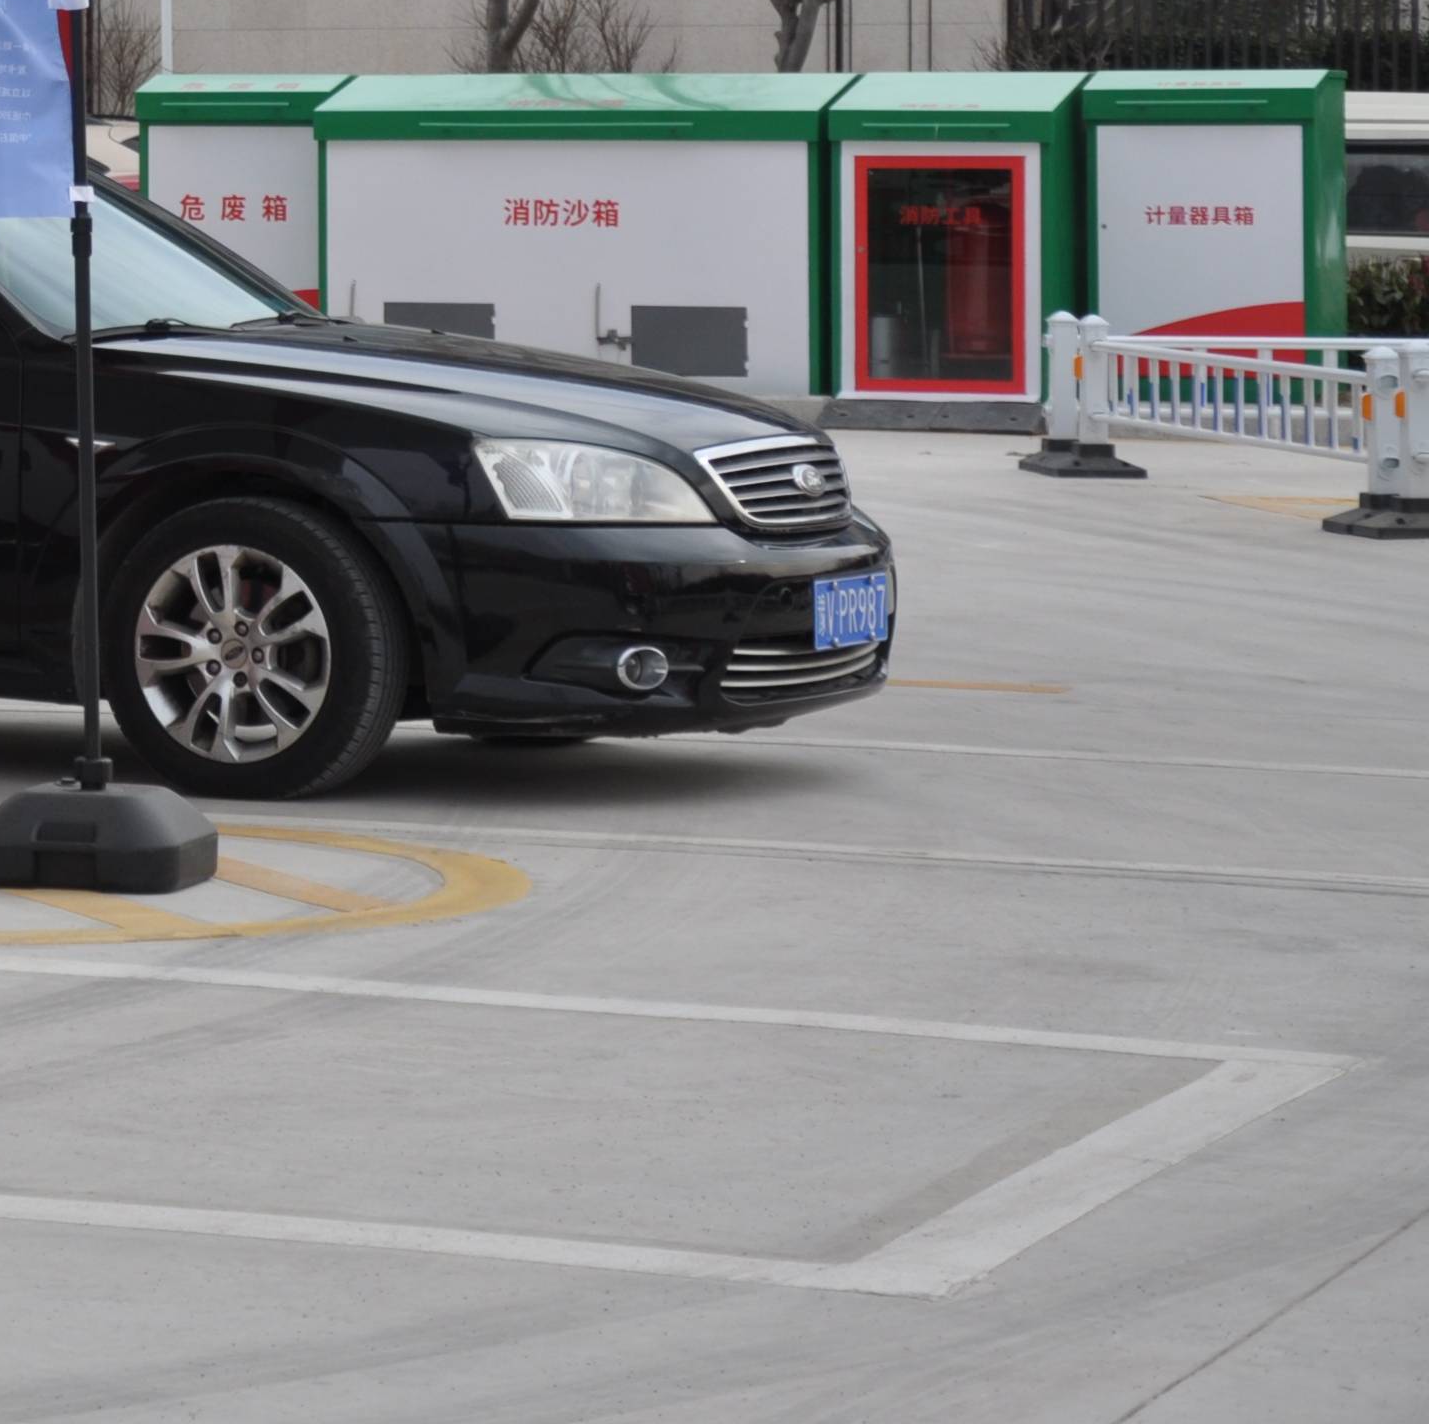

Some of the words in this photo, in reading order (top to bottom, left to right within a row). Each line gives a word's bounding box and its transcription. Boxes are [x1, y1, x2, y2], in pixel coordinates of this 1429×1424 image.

[180, 195, 288, 222] 危废箱
[504, 199, 620, 228] 消防沙箱
[901, 206, 982, 226] 消防工具
[1146, 206, 1254, 226] 计量器具箱
